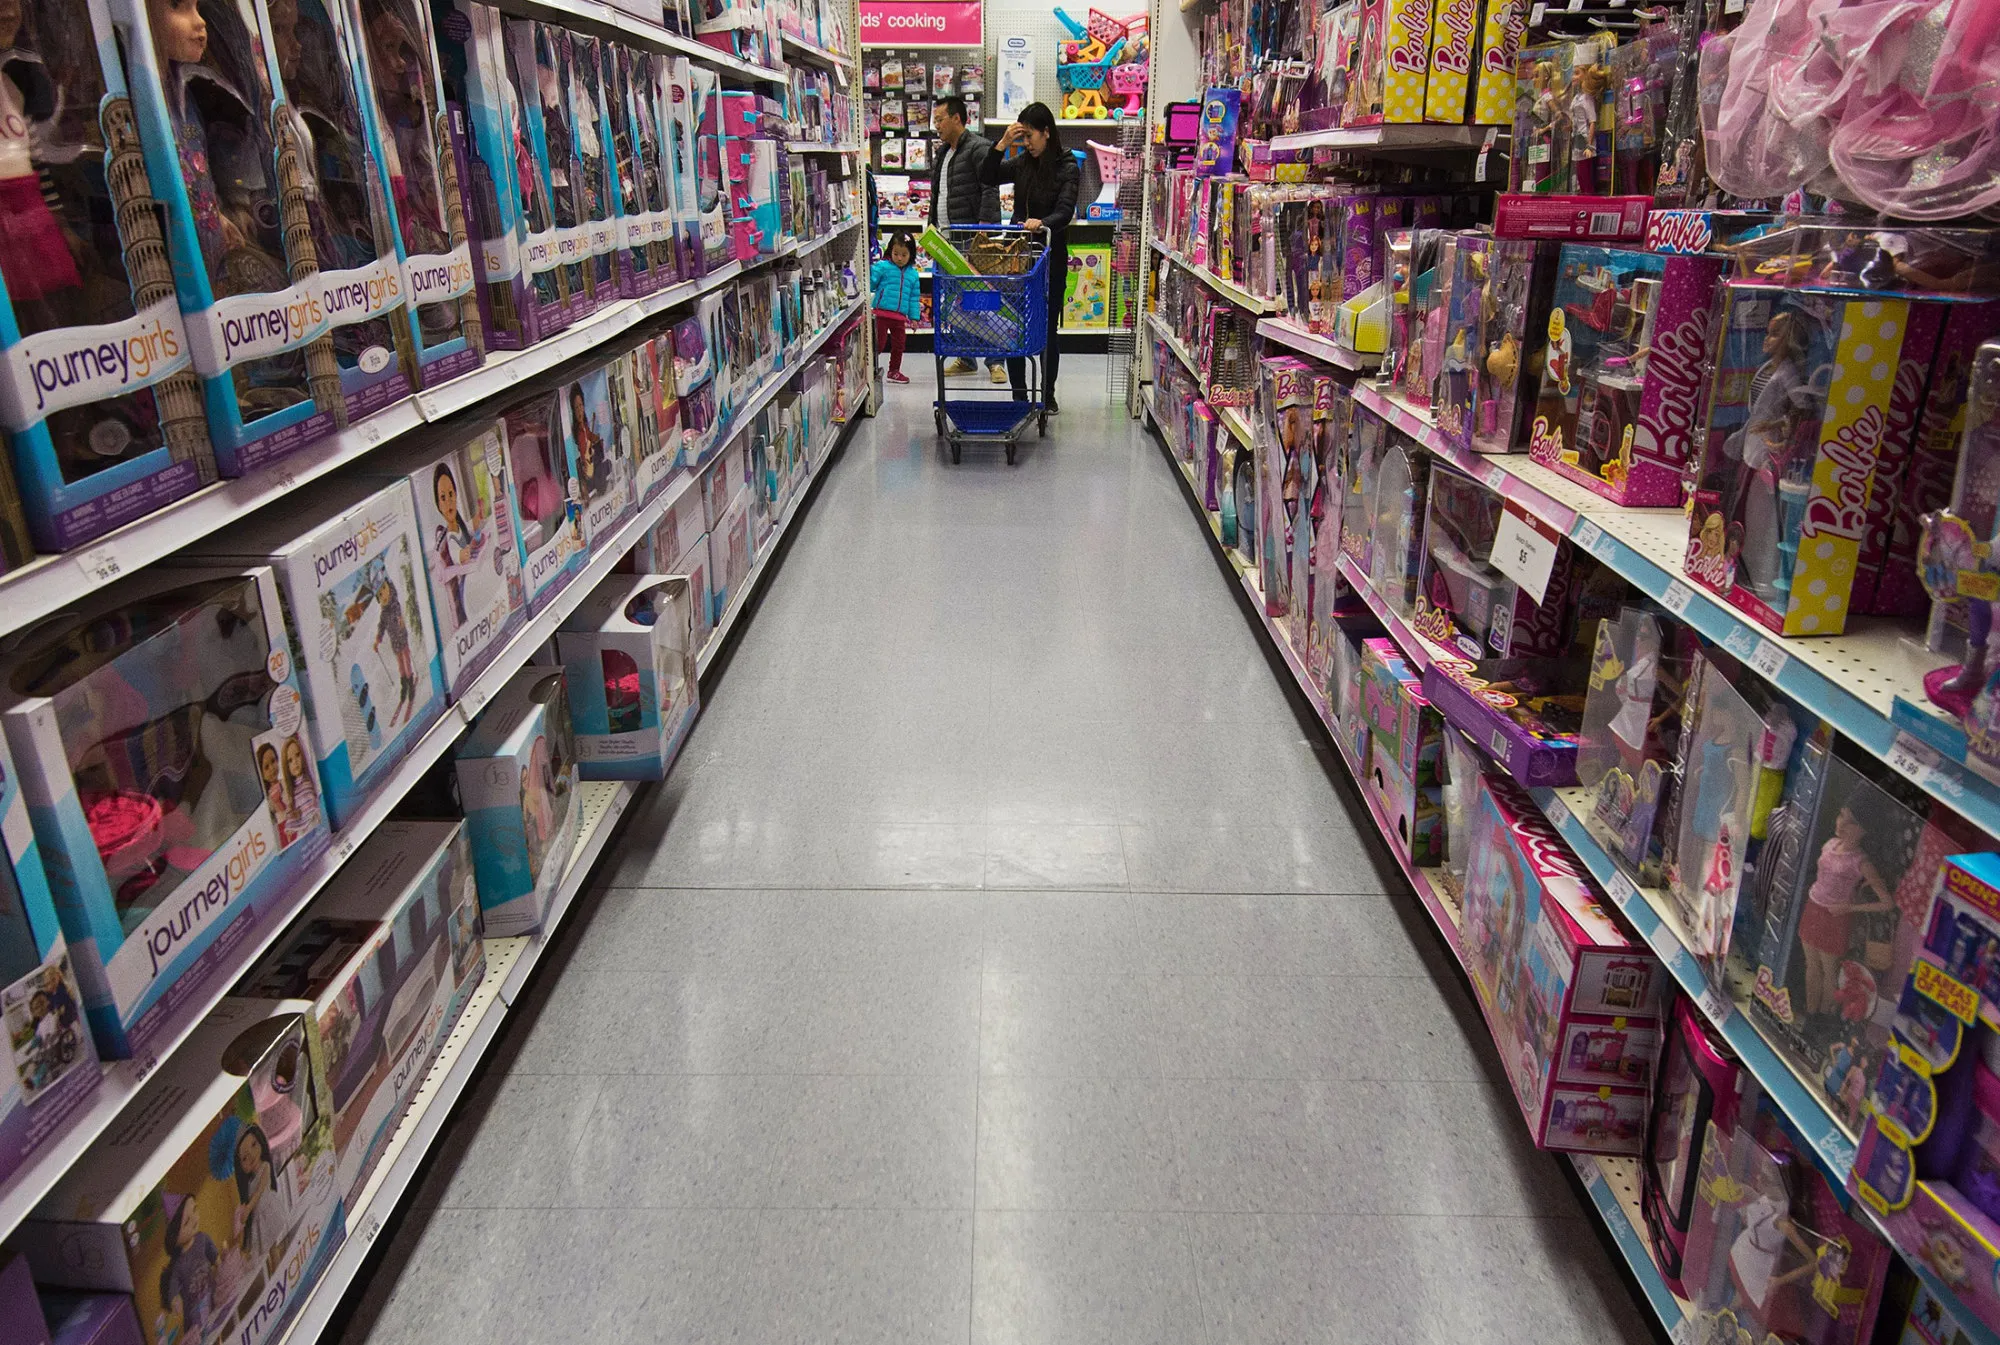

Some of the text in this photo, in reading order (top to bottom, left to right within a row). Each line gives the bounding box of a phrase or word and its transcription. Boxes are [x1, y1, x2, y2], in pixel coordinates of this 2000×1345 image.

[859, 12, 946, 31] ids' cooking
[1390, 0, 1430, 75] Barbie
[1433, 0, 1475, 75] Barbie
[1643, 211, 1711, 255] Barbie
[323, 261, 398, 316] ourneygirls
[26, 320, 179, 407] journeygirls
[218, 296, 322, 360] journeygirls
[1634, 307, 1710, 470] Barbie
[1802, 404, 1885, 542] Barbie
[312, 517, 379, 588] journeygirls
[1685, 537, 1726, 588] Barbie
[1414, 596, 1448, 640] Barbie
[144, 829, 267, 979] journeygirls
[1950, 868, 1999, 907] OPENS
[241, 1222, 320, 1345] rneygirls
